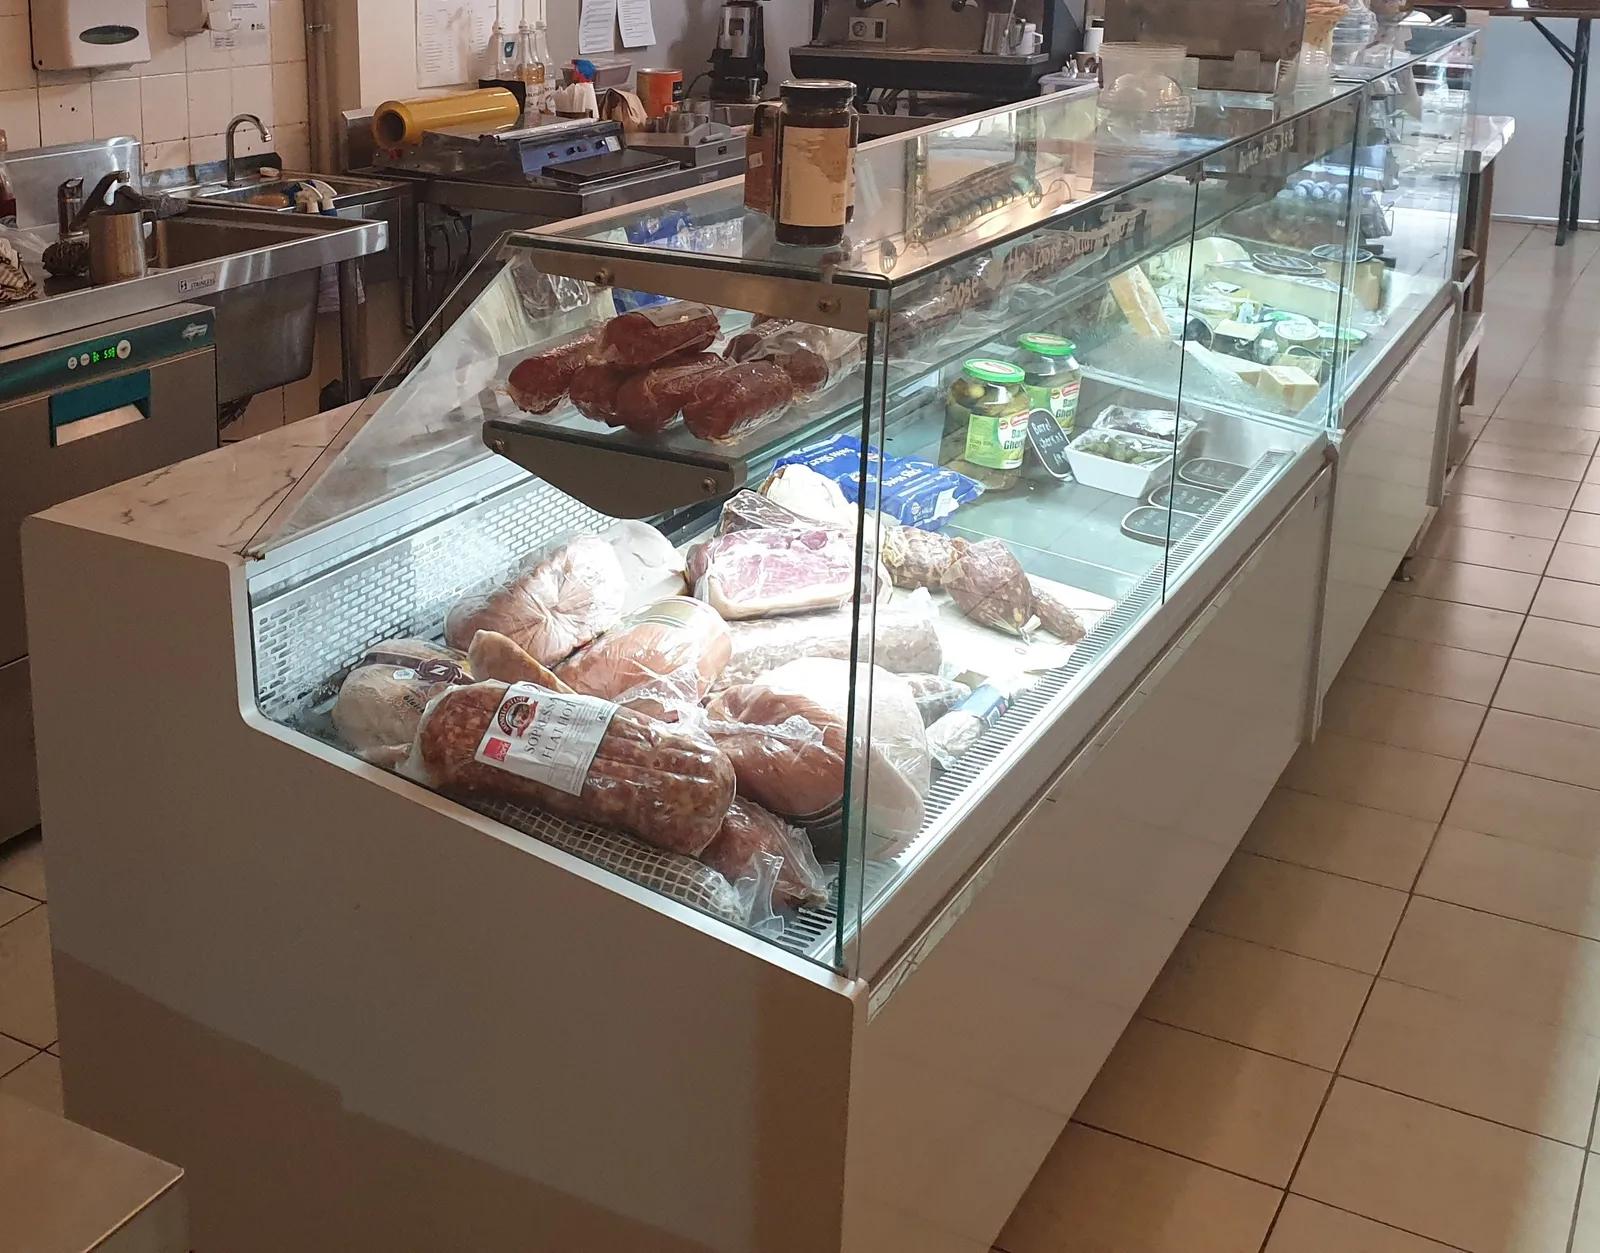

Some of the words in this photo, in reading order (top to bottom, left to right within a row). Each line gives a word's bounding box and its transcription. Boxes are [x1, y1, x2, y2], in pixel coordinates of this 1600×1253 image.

[1031, 418, 1052, 435] Barrel
[542, 727, 565, 760] FLAT
[560, 700, 578, 728] HOT
